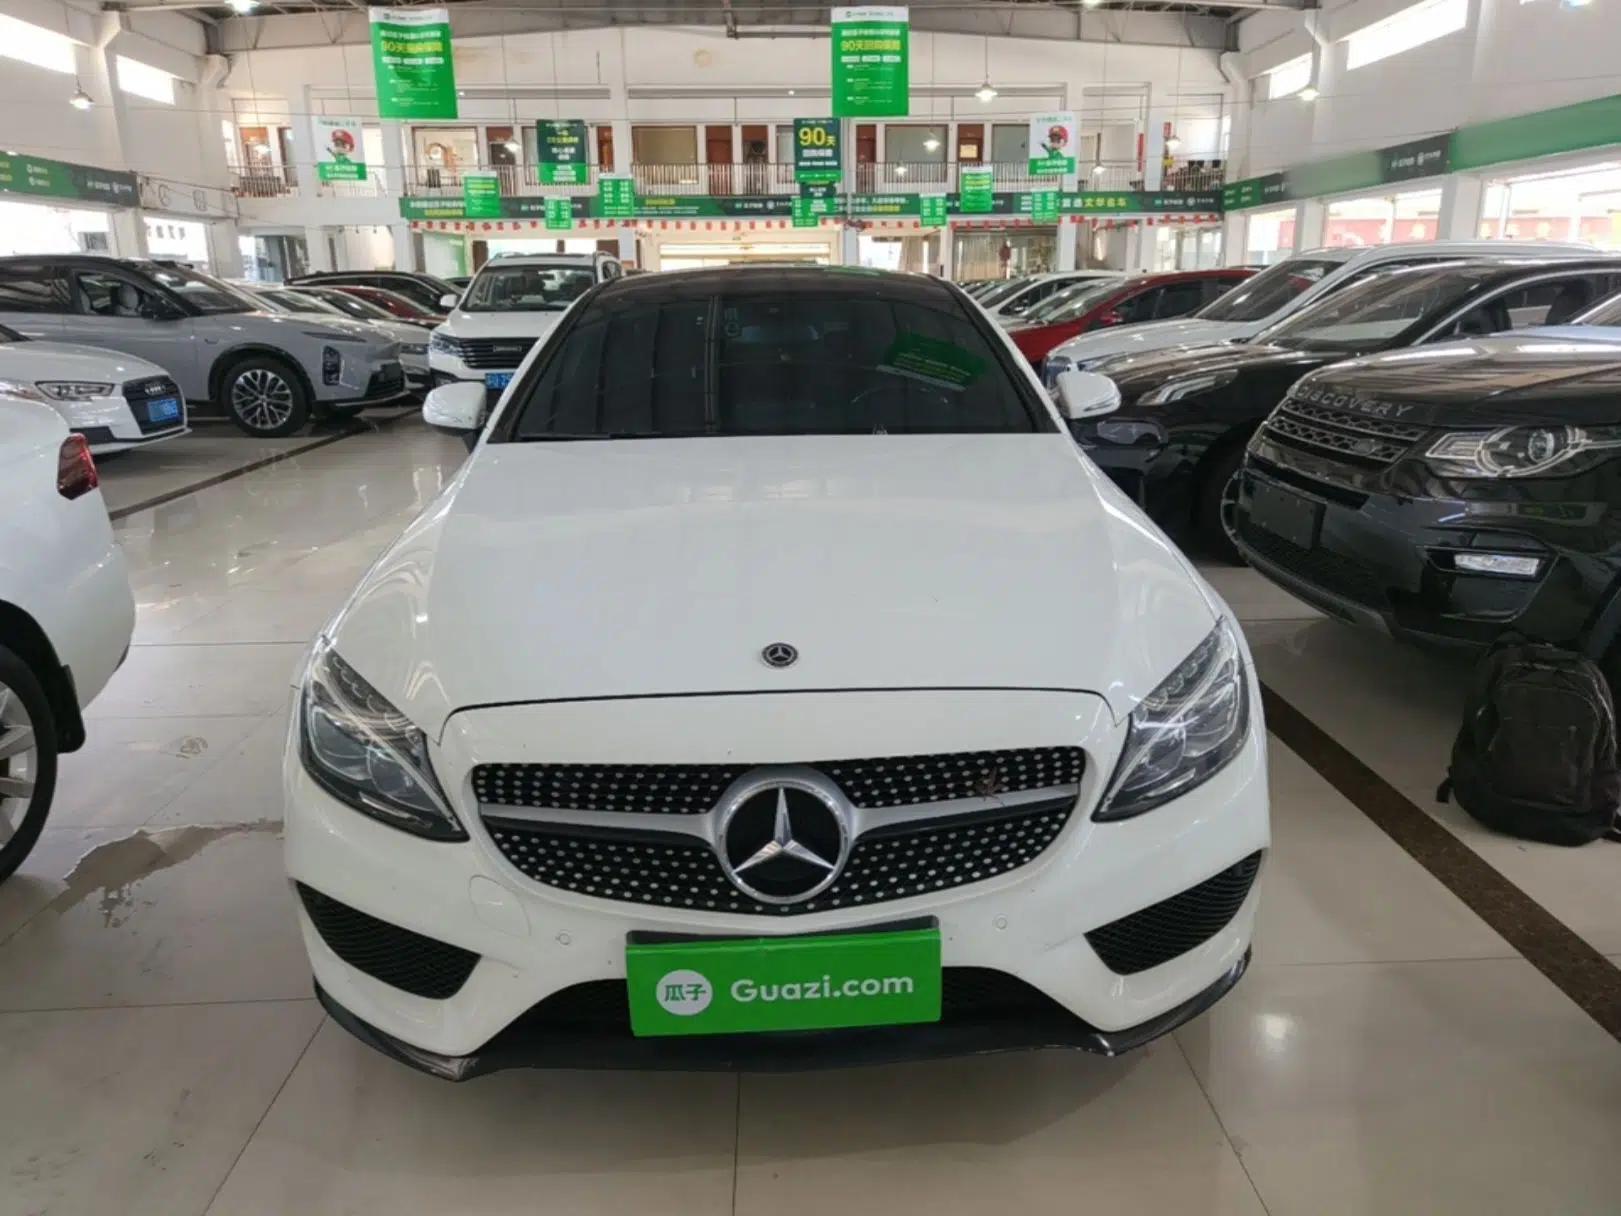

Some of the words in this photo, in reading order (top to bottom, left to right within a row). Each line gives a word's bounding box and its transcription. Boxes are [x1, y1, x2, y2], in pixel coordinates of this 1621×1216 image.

[799, 126, 836, 147] 90天
[1296, 384, 1415, 417] DISCOVERY
[663, 983, 707, 1002] 瓜子
[730, 975, 914, 1002] Guazi.com
